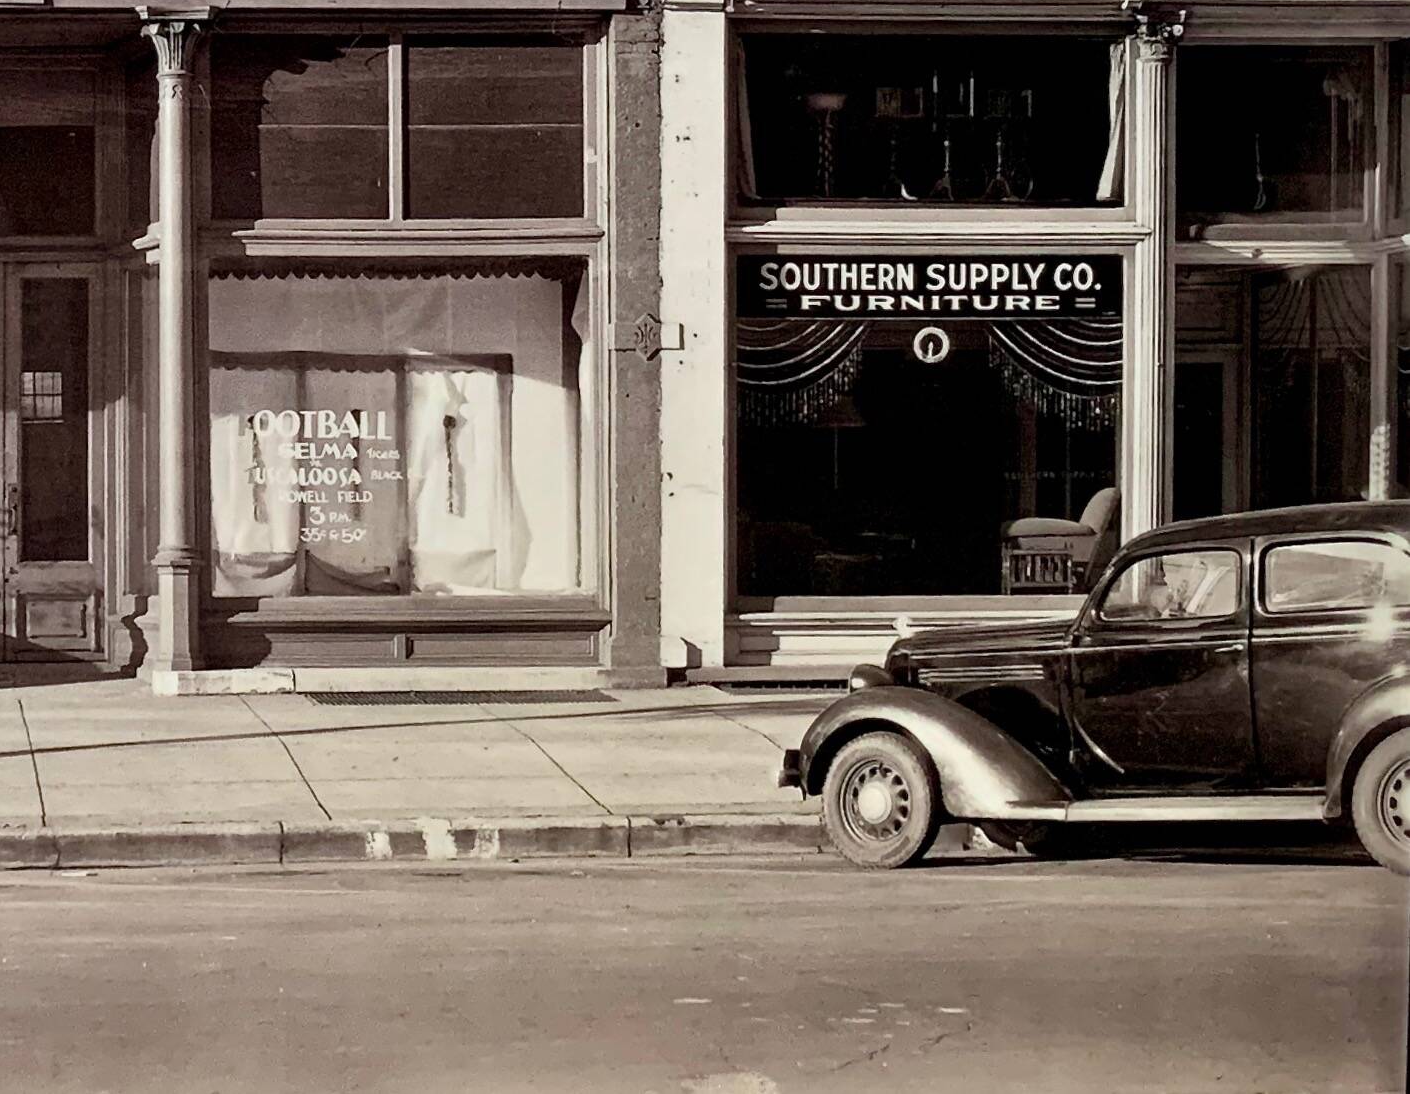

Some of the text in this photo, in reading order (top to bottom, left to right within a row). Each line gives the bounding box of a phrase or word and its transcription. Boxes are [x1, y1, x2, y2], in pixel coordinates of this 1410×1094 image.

[759, 262, 1102, 292] SOUTHERN SUPPLY CO.
[800, 295, 1061, 311] FURNITURE
[244, 409, 393, 441] OOTBALL
[278, 443, 359, 461] SELMA
[246, 466, 362, 488] USALOOSA
[280, 491, 373, 504] OWELL FIELD
[309, 506, 325, 524] 3
